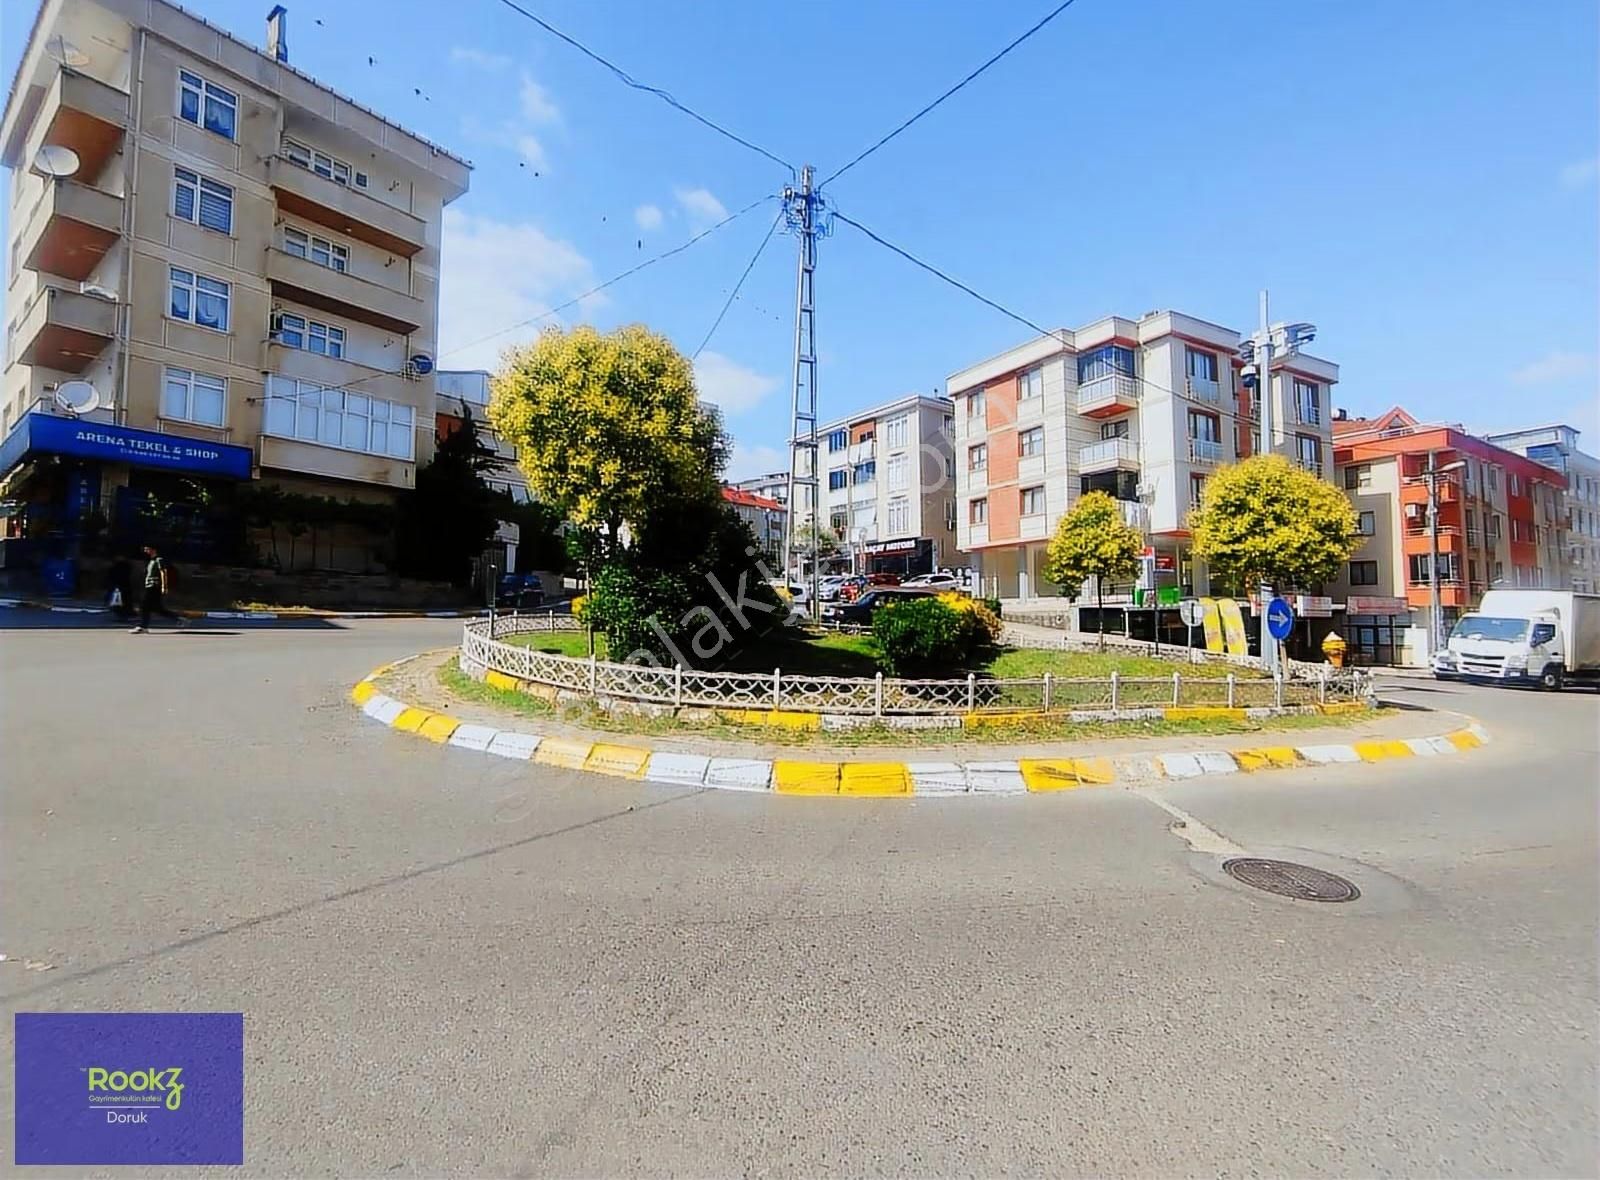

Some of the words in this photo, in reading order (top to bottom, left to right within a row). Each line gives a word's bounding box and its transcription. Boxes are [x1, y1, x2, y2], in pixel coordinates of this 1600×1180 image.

[76, 431, 125, 446] ARENA
[129, 439, 170, 454] TEKEL
[172, 446, 182, 454] &
[185, 448, 219, 460] SHOP
